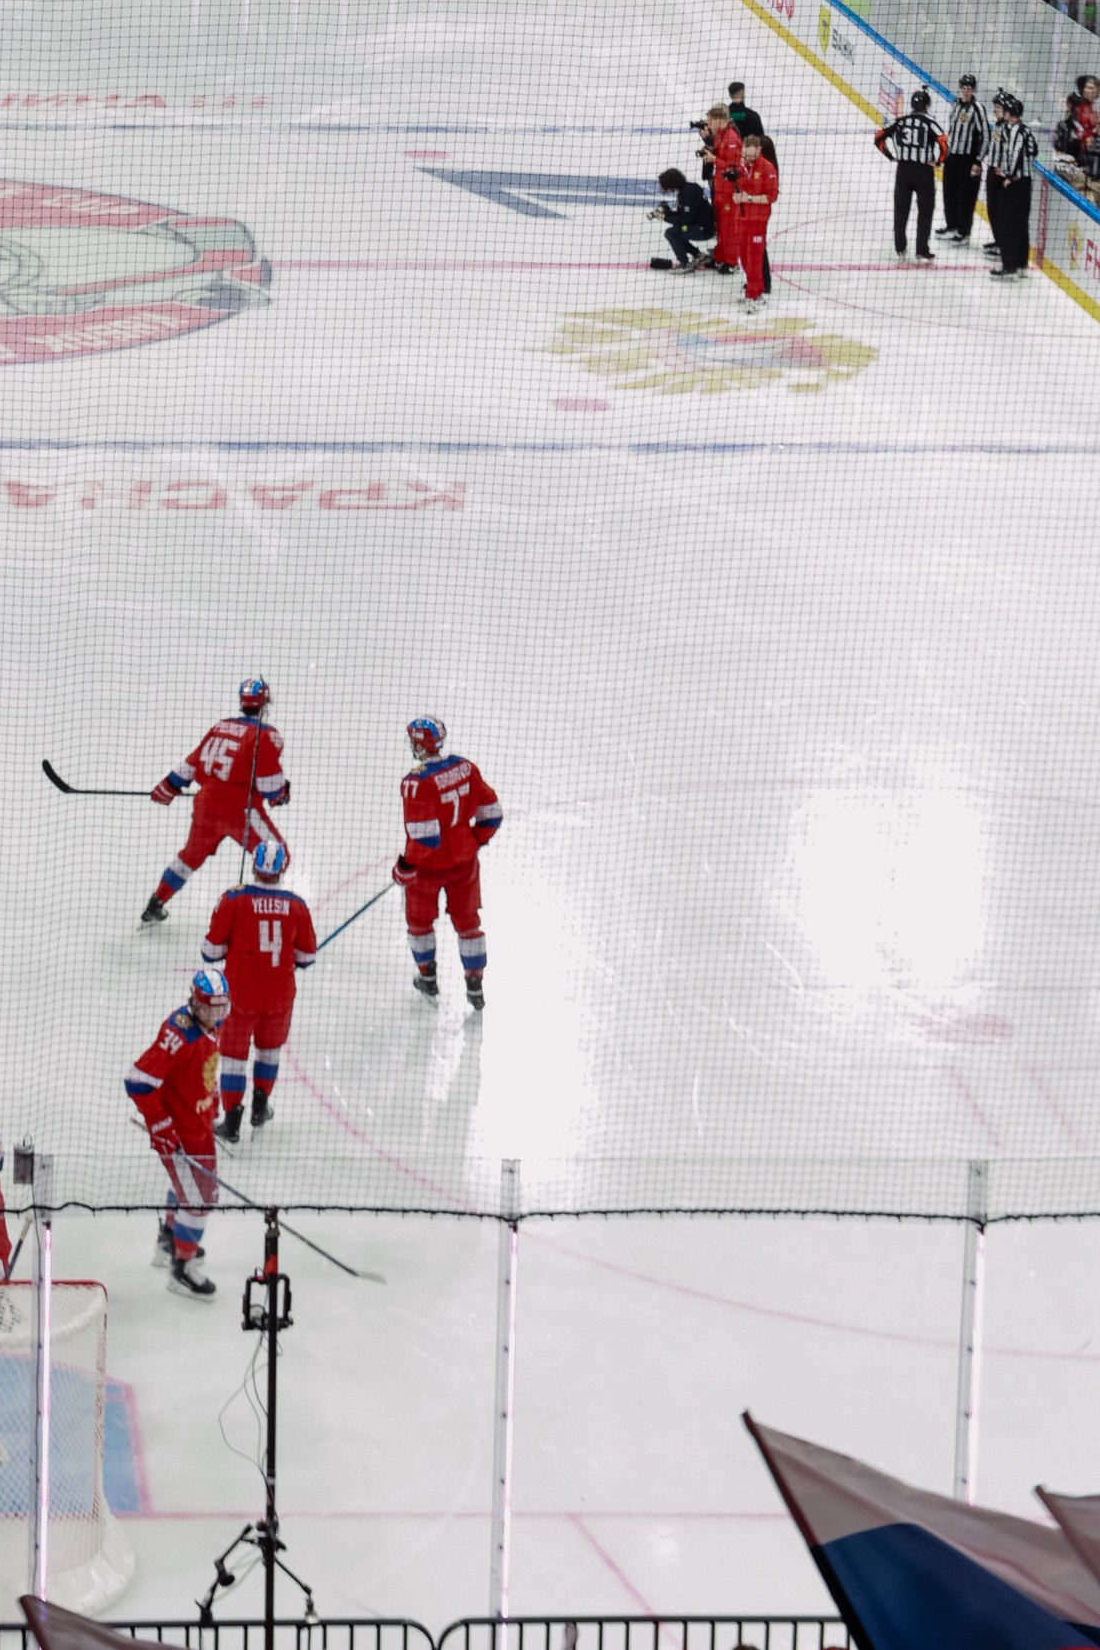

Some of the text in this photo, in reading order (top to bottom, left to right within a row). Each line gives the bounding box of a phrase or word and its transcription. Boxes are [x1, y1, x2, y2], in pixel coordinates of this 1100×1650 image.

[902, 127, 920, 146] 31
[42, 196, 142, 216] CUP
[199, 735, 241, 782] 45
[251, 897, 290, 917] YELESIN
[258, 919, 283, 967] 4
[158, 1029, 183, 1056] 34
